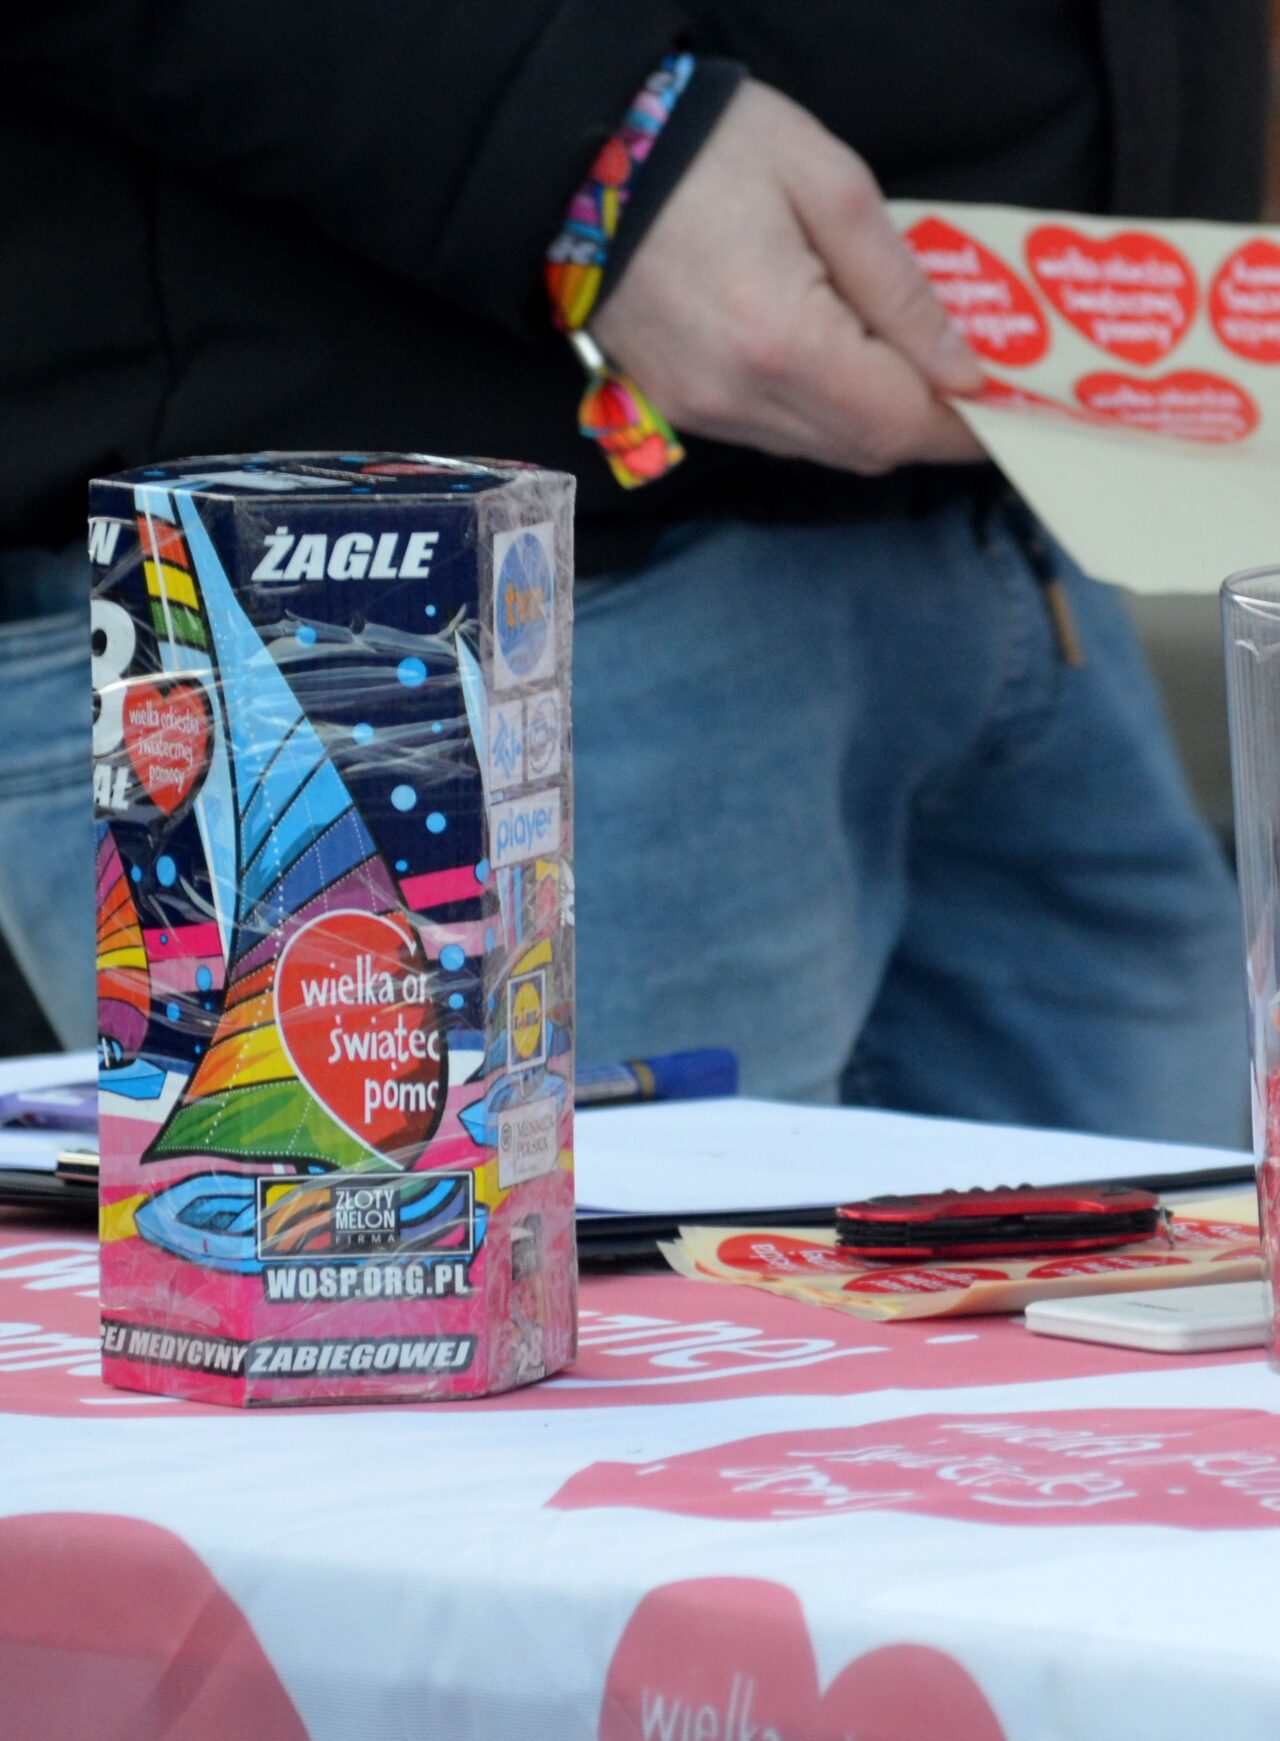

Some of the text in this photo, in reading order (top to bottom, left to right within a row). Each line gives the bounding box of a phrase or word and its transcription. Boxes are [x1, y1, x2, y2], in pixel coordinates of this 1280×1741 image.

[251, 526, 439, 581] ŻAGLE
[497, 805, 555, 859] player
[301, 954, 394, 1007] wielka
[336, 1189, 394, 1210] ZŁOTY
[336, 1210, 395, 1229] MELON
[336, 1234, 395, 1244] FIRMA
[267, 1263, 469, 1299] WOSP.ORG.PL
[128, 1332, 247, 1372] MEDYCYNY
[250, 1340, 471, 1373] ZABIEGOWEJ
